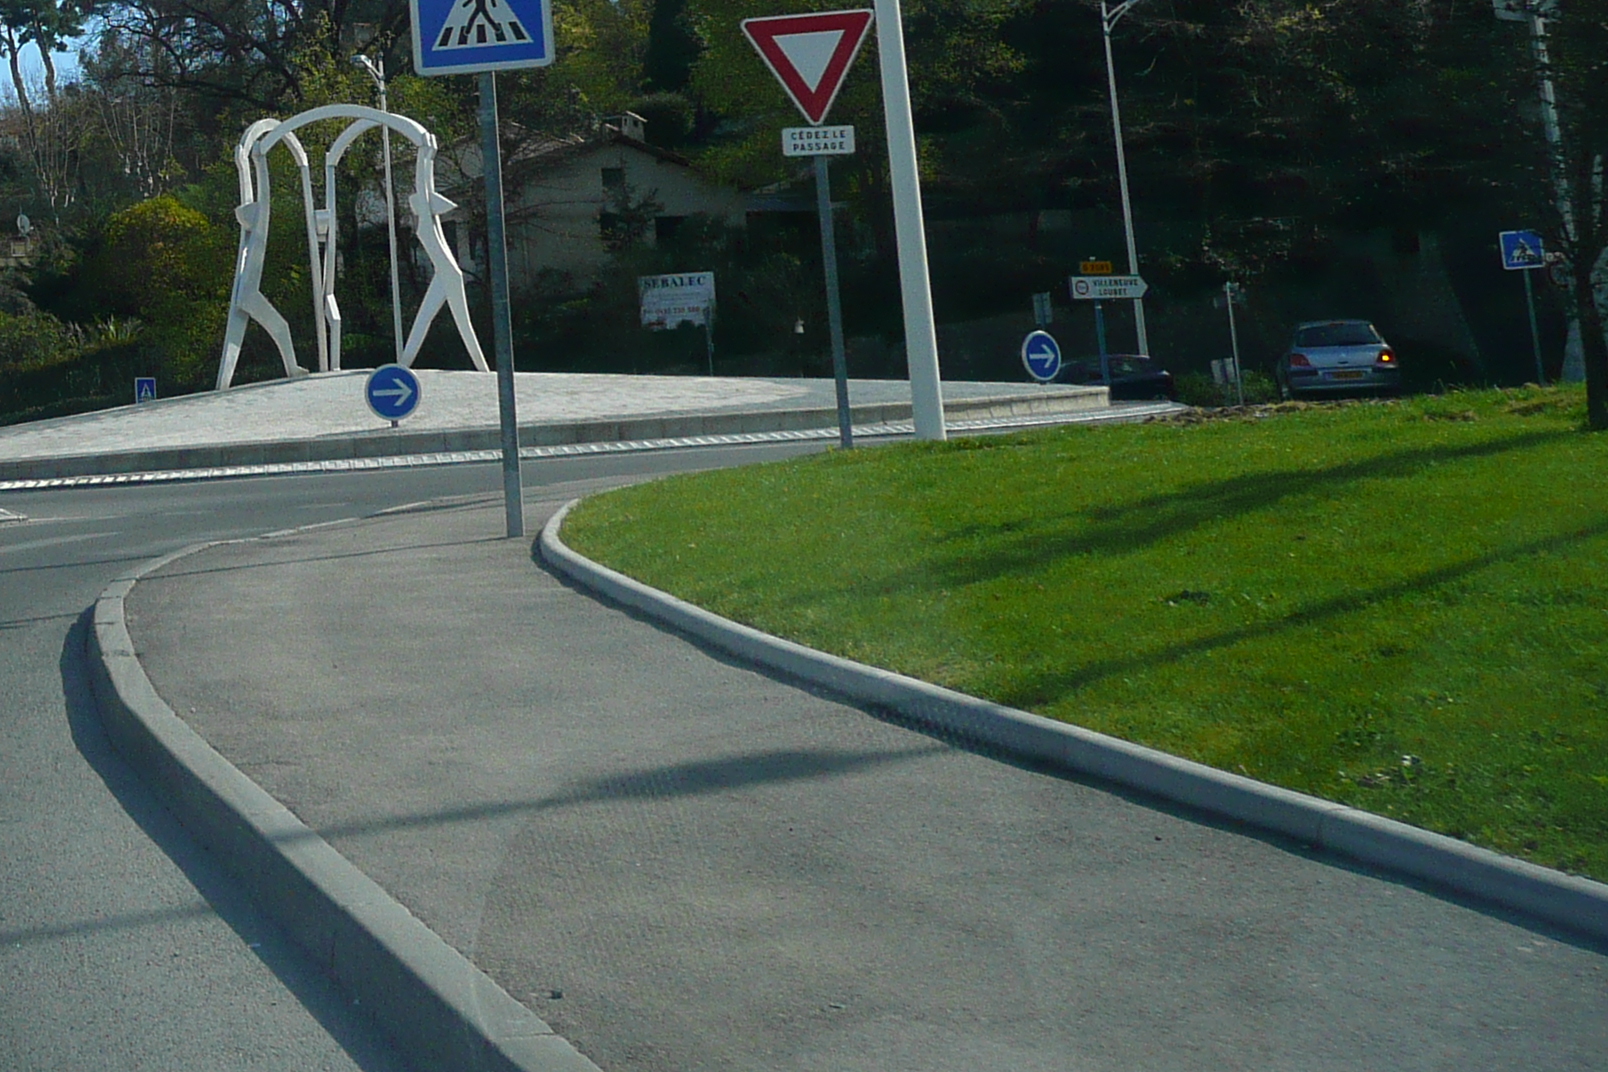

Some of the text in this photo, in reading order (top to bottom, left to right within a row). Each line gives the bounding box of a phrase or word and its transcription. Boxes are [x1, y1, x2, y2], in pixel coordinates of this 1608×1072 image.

[791, 130, 846, 140] CÉDEZ LE
[793, 142, 845, 151] PASSAGE
[1092, 278, 1139, 287] VILLENEUVE
[1098, 288, 1128, 296] LOUBET
